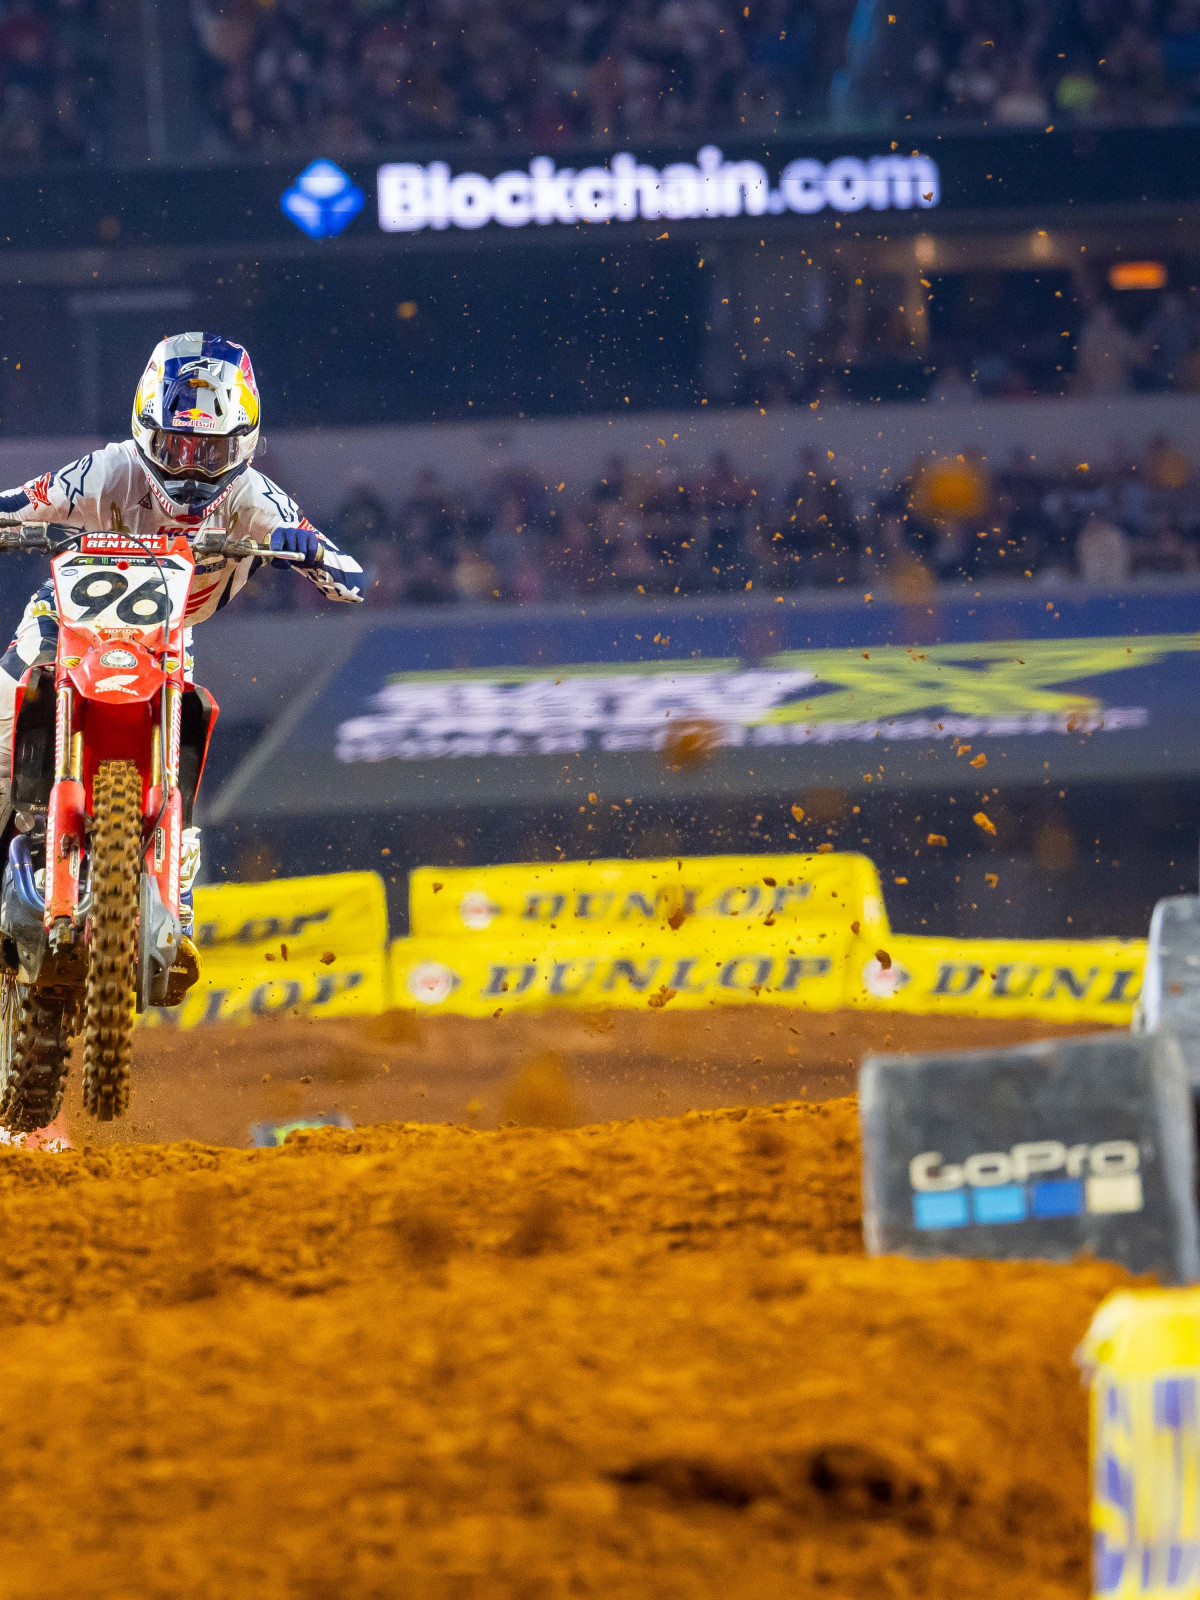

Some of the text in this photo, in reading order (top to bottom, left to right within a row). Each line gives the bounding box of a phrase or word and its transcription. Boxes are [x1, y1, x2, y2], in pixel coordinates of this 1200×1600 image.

[377, 144, 941, 232] Blockchain.com
[172, 419, 216, 429] Red Bull
[86, 540, 162, 549] RENTHAL
[70, 571, 174, 625] 96
[94, 687, 140, 697] HONDA
[168, 814, 180, 906] DUNLOP
[522, 881, 812, 922] DUNLOP
[482, 954, 832, 1000] DUNLOP
[931, 960, 1142, 1003] DUNL
[910, 1140, 1140, 1191] GoPro
